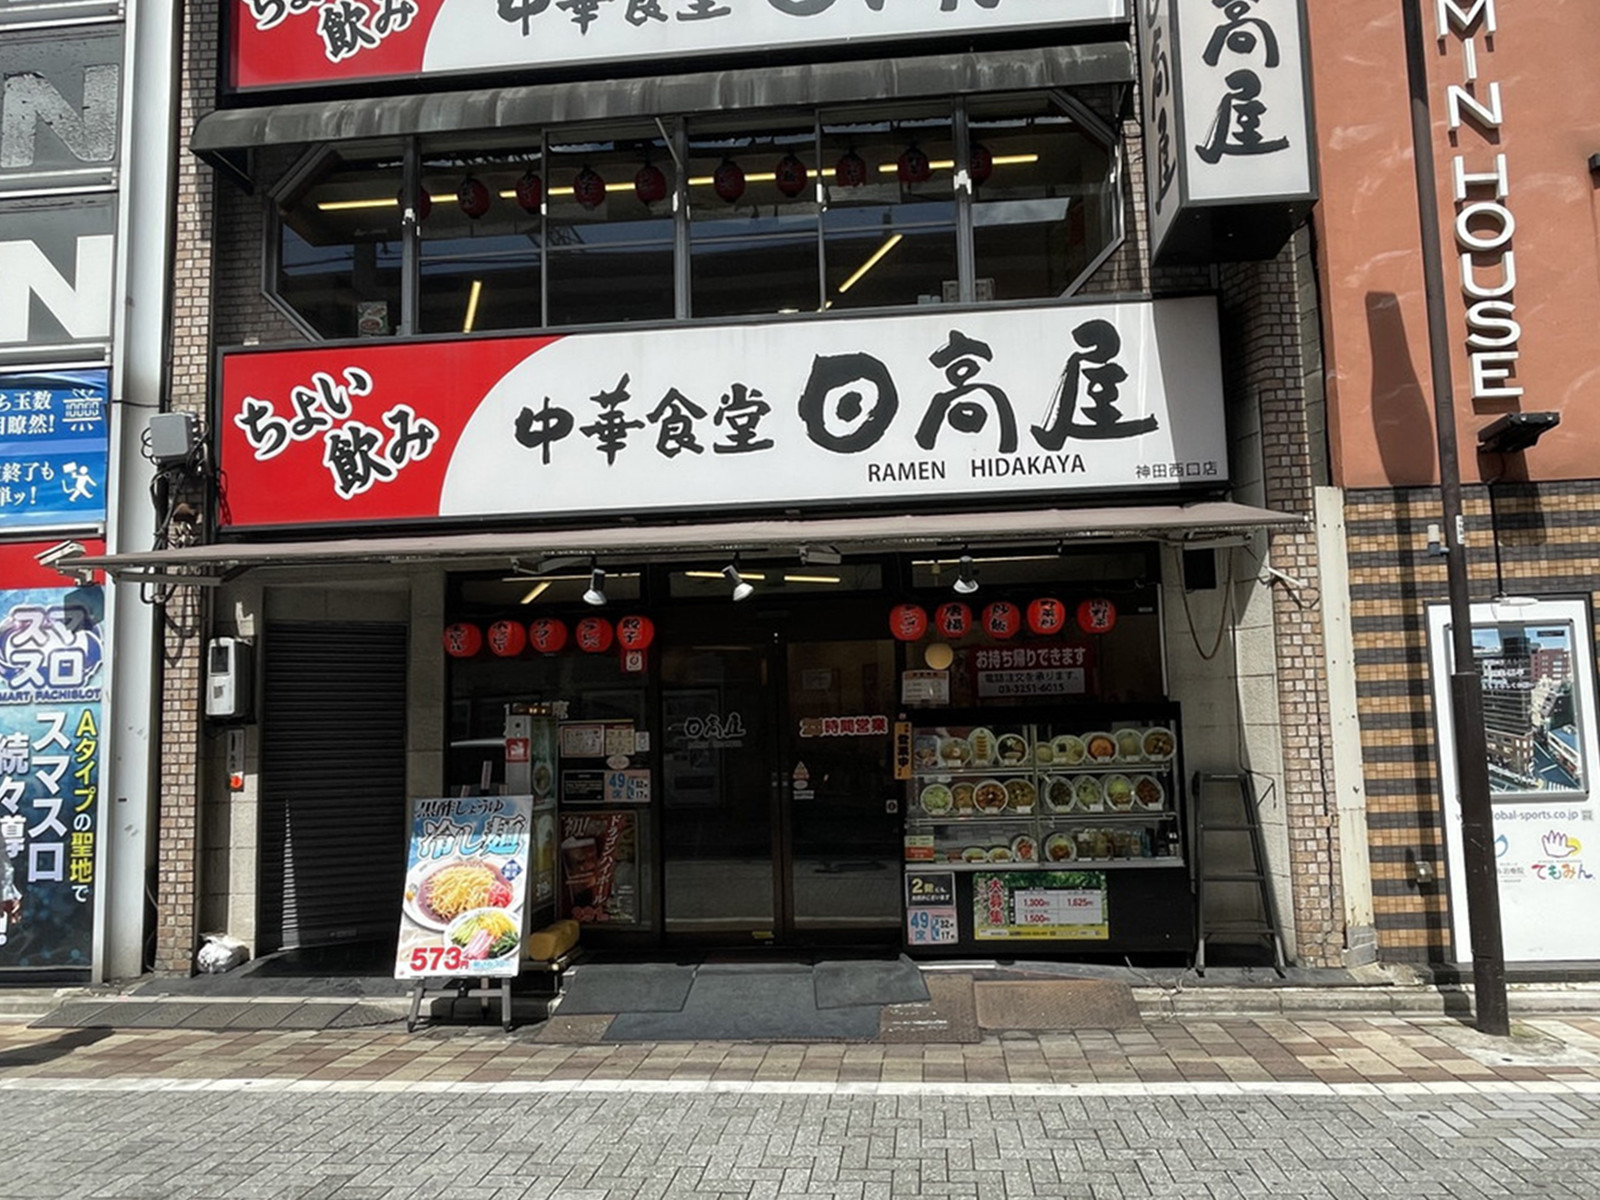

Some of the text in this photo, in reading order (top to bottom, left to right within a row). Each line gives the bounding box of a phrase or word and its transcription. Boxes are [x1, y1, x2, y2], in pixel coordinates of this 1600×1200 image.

[1437, 0, 1502, 131] MIN
[1453, 153, 1524, 399] HOUSE
[798, 319, 1160, 454] 日高屋
[234, 366, 374, 462] ちょい
[514, 372, 774, 467] 中華食堂
[322, 404, 440, 500] 飲み
[868, 454, 1086, 482] RAMEN HIDAKAYA
[1136, 462, 1218, 480] 神田西口店
[10, 649, 85, 689] スロ
[975, 648, 1086, 669] お持ち帰りできます
[821, 715, 889, 735] 時間営業
[27, 711, 72, 882] スマスロ
[69, 709, 98, 903] Aタイプの聖地で
[416, 800, 505, 818] 黒酢しょうゆ
[418, 815, 526, 860] 冷し麺
[1531, 863, 1593, 880] てもみん
[910, 912, 929, 929] 49
[409, 947, 470, 972] 573円
